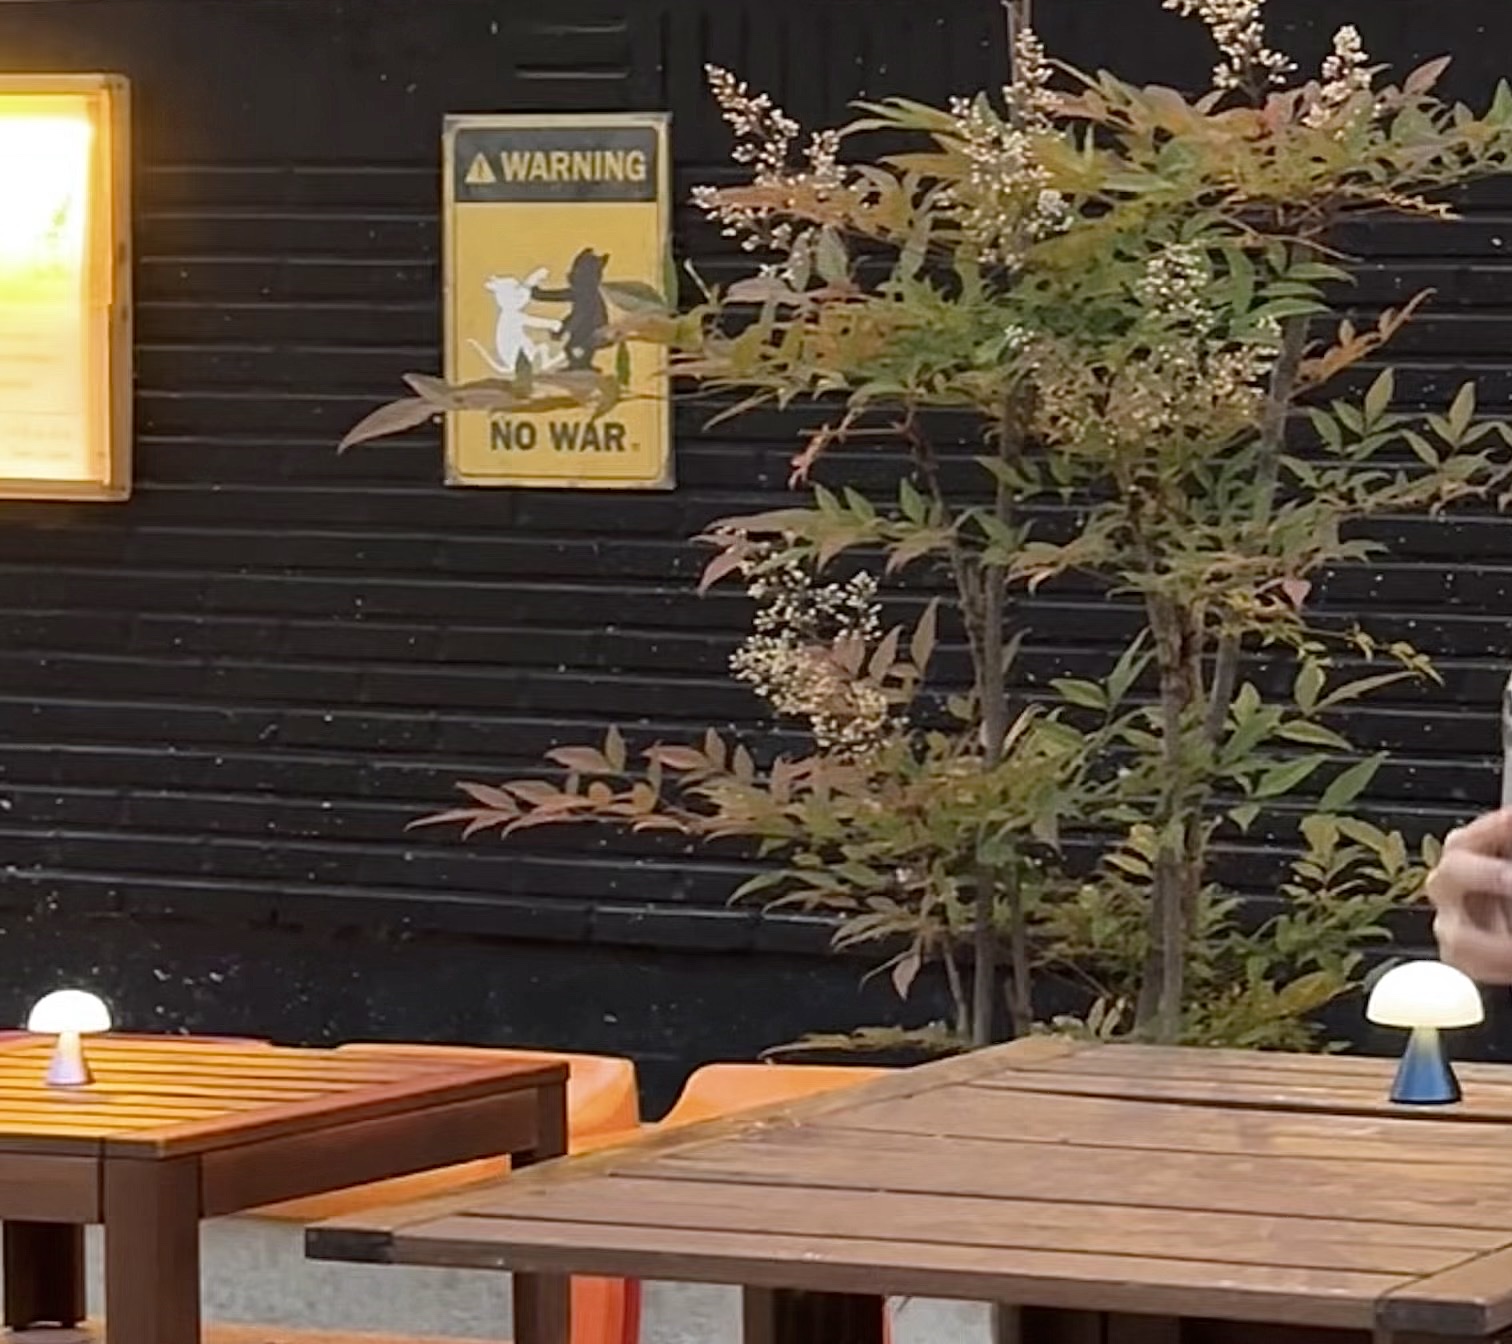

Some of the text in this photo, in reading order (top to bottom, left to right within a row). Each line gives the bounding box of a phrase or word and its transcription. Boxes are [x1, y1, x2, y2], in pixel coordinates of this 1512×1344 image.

[500, 149, 648, 184] WARNING
[490, 420, 628, 453] NO WAR
